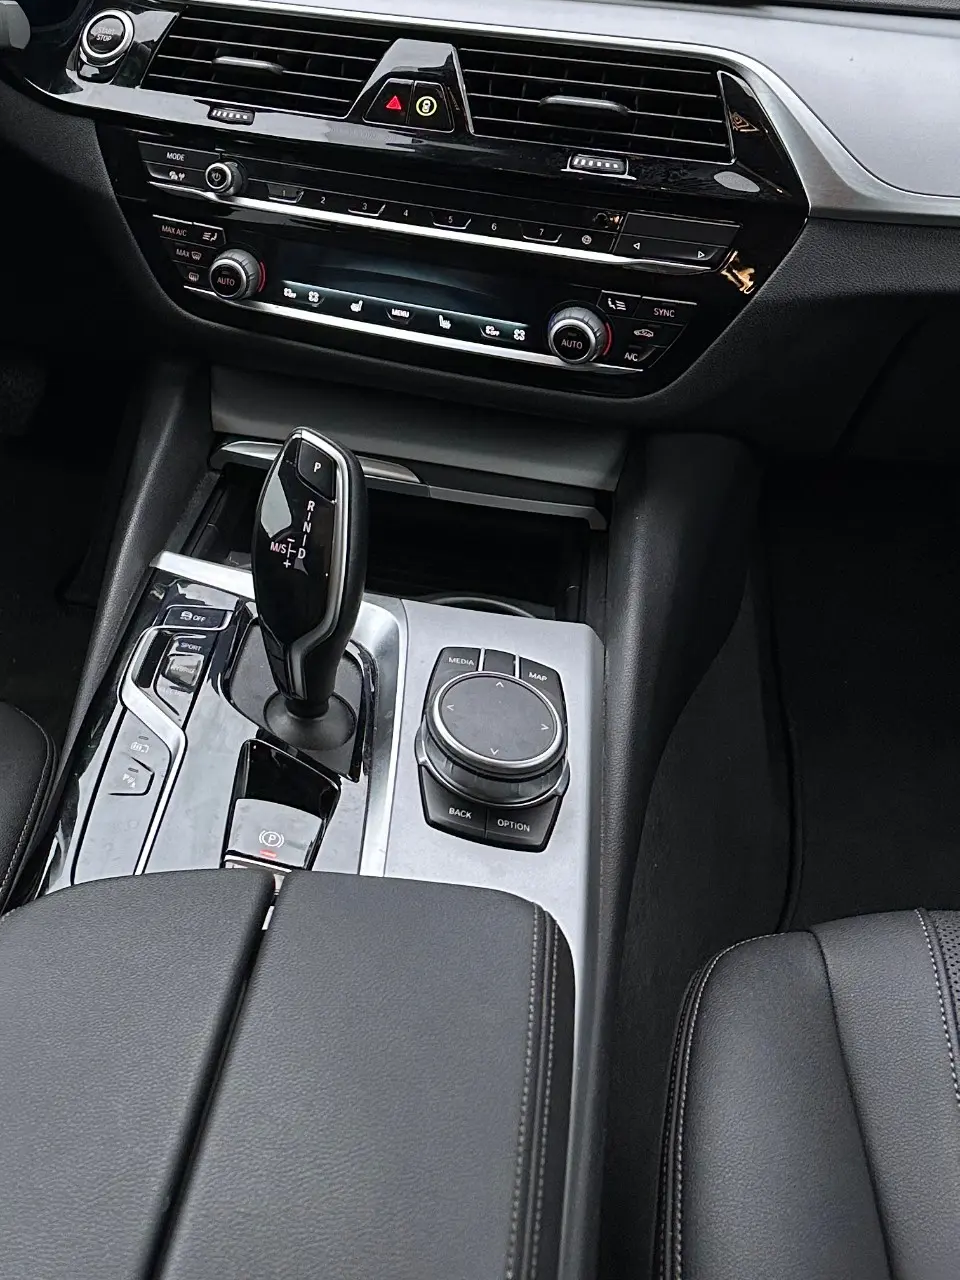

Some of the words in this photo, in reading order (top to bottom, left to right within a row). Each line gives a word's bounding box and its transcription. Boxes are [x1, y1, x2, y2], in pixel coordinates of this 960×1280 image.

[96, 34, 112, 42] STOP
[166, 152, 185, 162] MODE
[161, 225, 176, 235] MAX
[176, 228, 187, 237] A/C
[176, 248, 190, 258] MAX
[217, 277, 235, 286] AUTO
[391, 308, 410, 318] MENU
[653, 307, 675, 318] SYNC
[561, 338, 583, 350] AUTO
[624, 351, 638, 362] A/C
[313, 462, 321, 472] P
[307, 500, 315, 512] R
[302, 521, 312, 533] N
[297, 548, 306, 559] D
[180, 641, 202, 651] SPORT
[448, 656, 475, 666] MEDIA
[528, 671, 547, 682] MAP
[448, 807, 472, 820] BACK
[497, 819, 530, 833] OPTION
